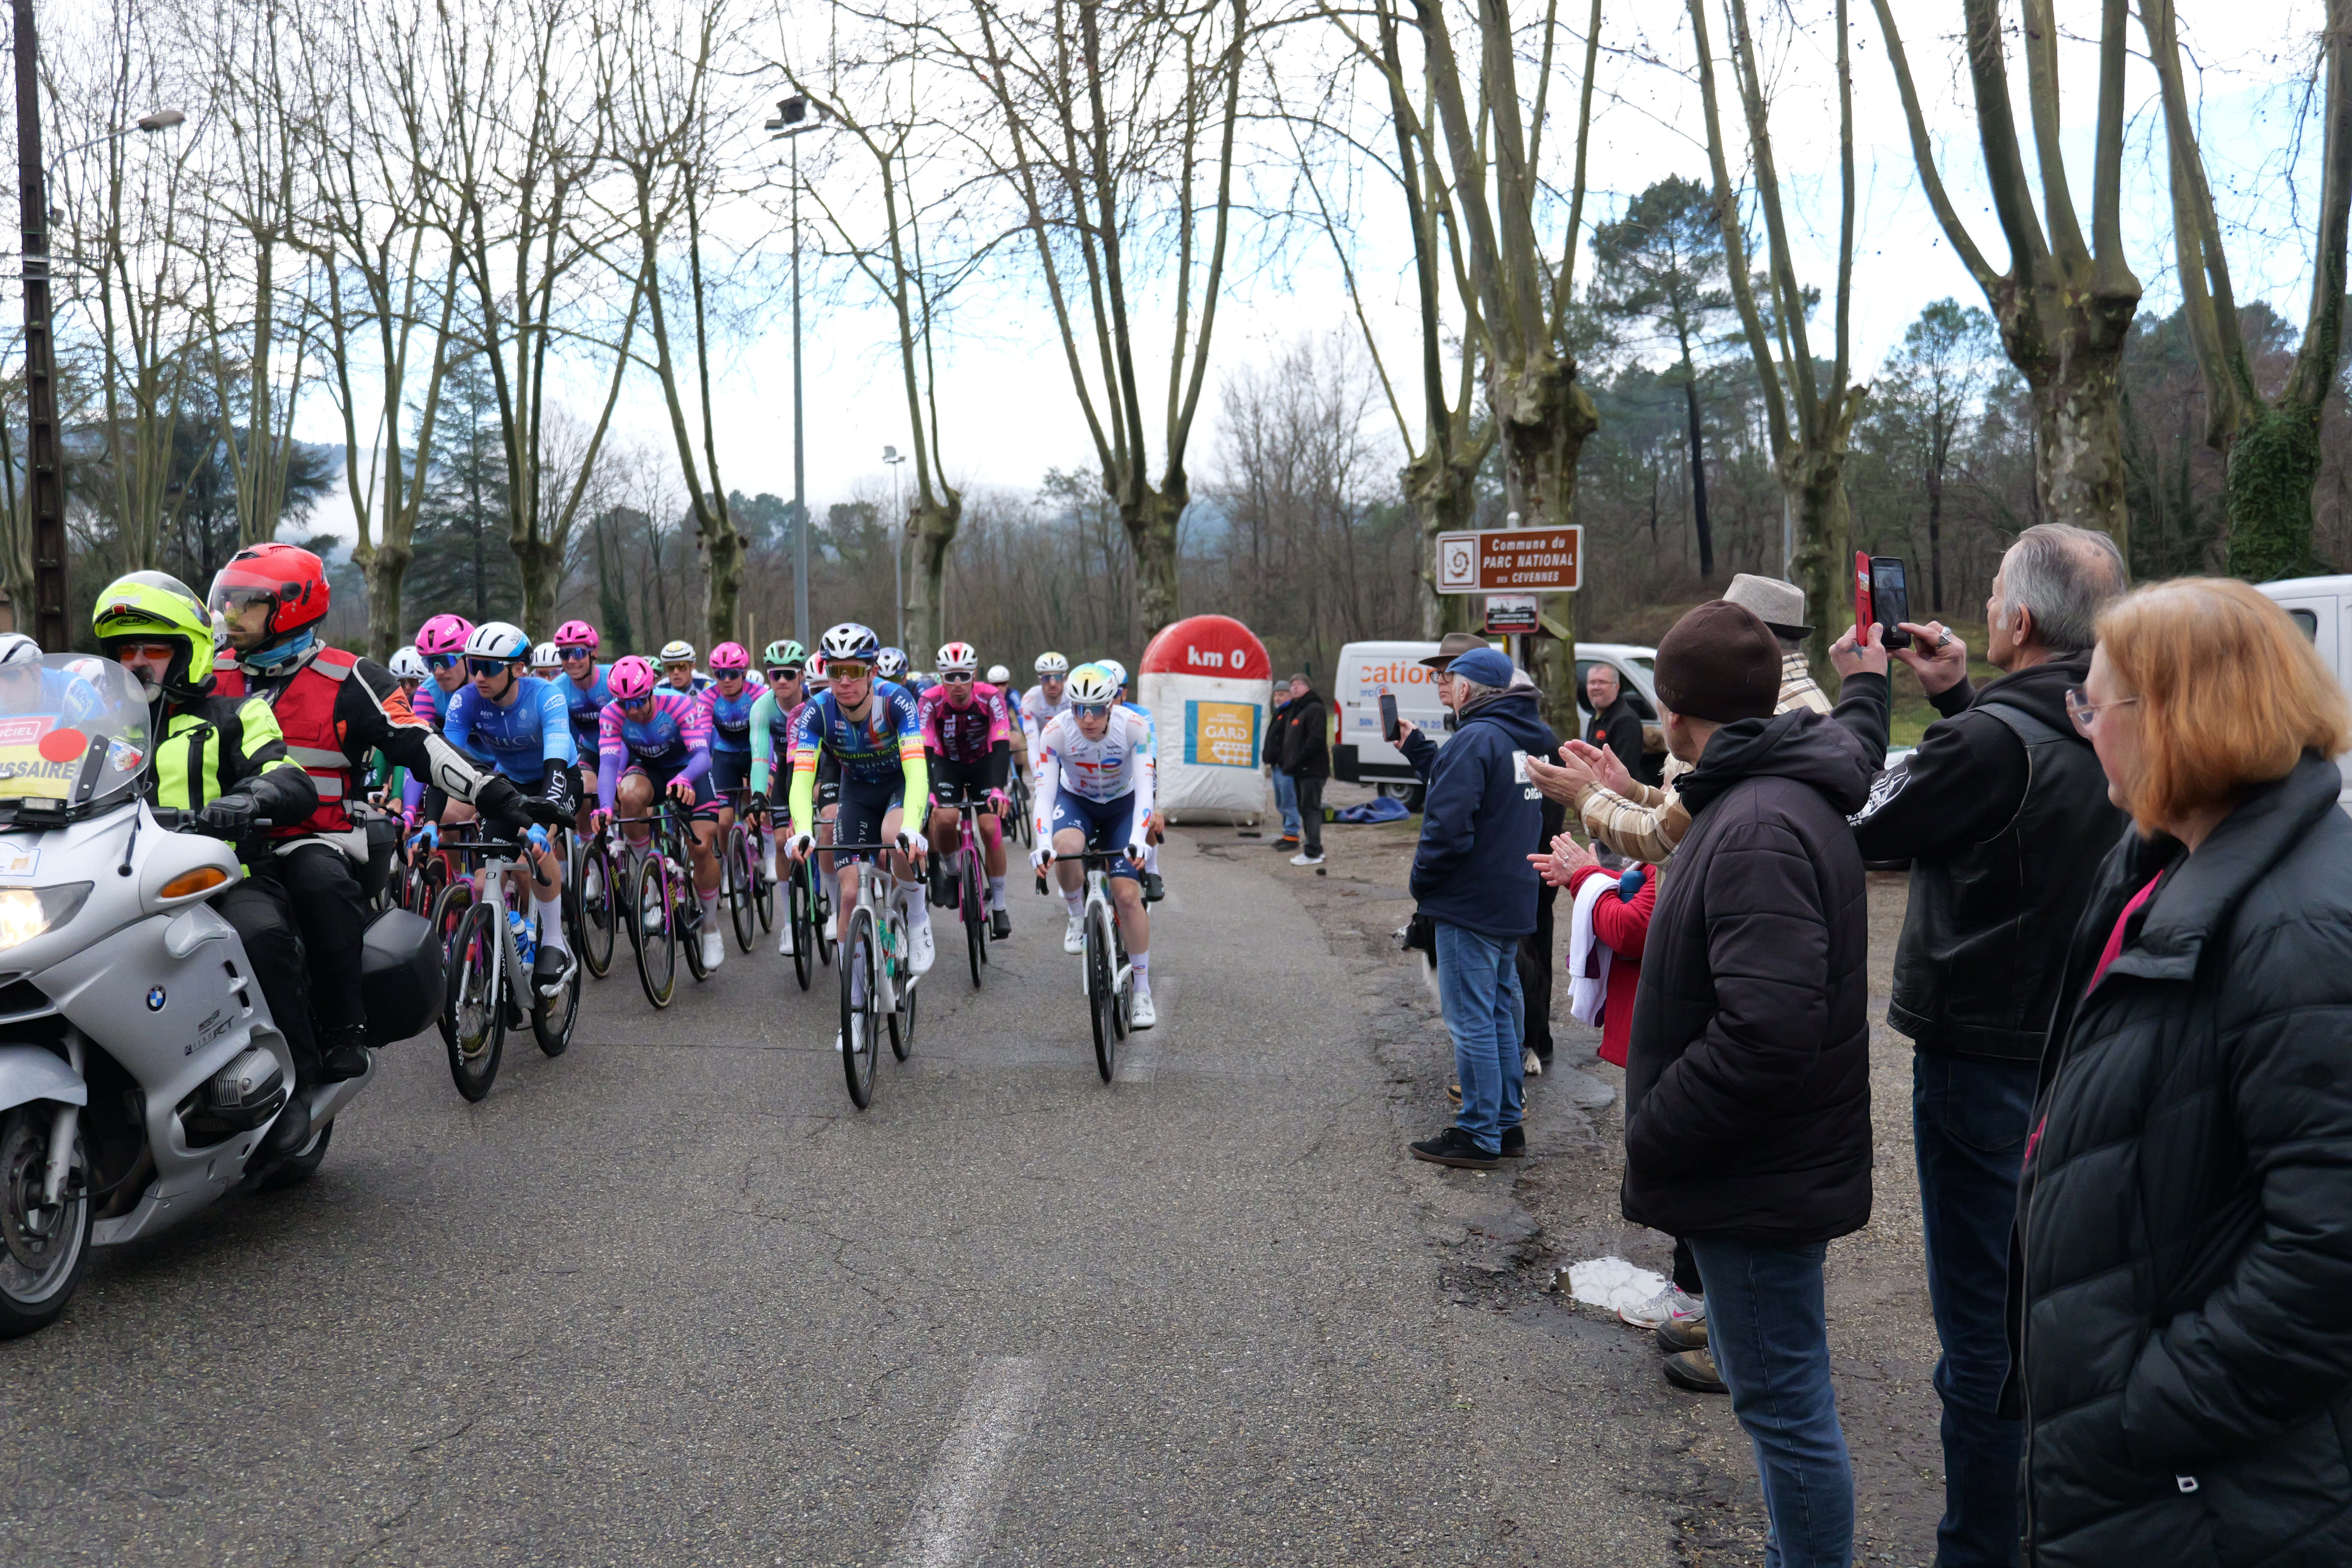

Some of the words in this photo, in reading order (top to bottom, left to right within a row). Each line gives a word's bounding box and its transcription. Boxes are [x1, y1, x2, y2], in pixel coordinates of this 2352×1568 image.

[1492, 539, 1546, 552] Commune
[1551, 536, 1566, 549] du
[1483, 555, 1513, 568] PARC
[1517, 553, 1573, 568] NATIONAL
[1512, 570, 1560, 583] CEVENNES
[1187, 645, 1224, 667] km
[1230, 649, 1245, 669] 0
[800, 707, 816, 730] NIPPO
[894, 695, 915, 729] FANTINI
[1205, 725, 1248, 740] GARD
[545, 769, 565, 806] NICE
